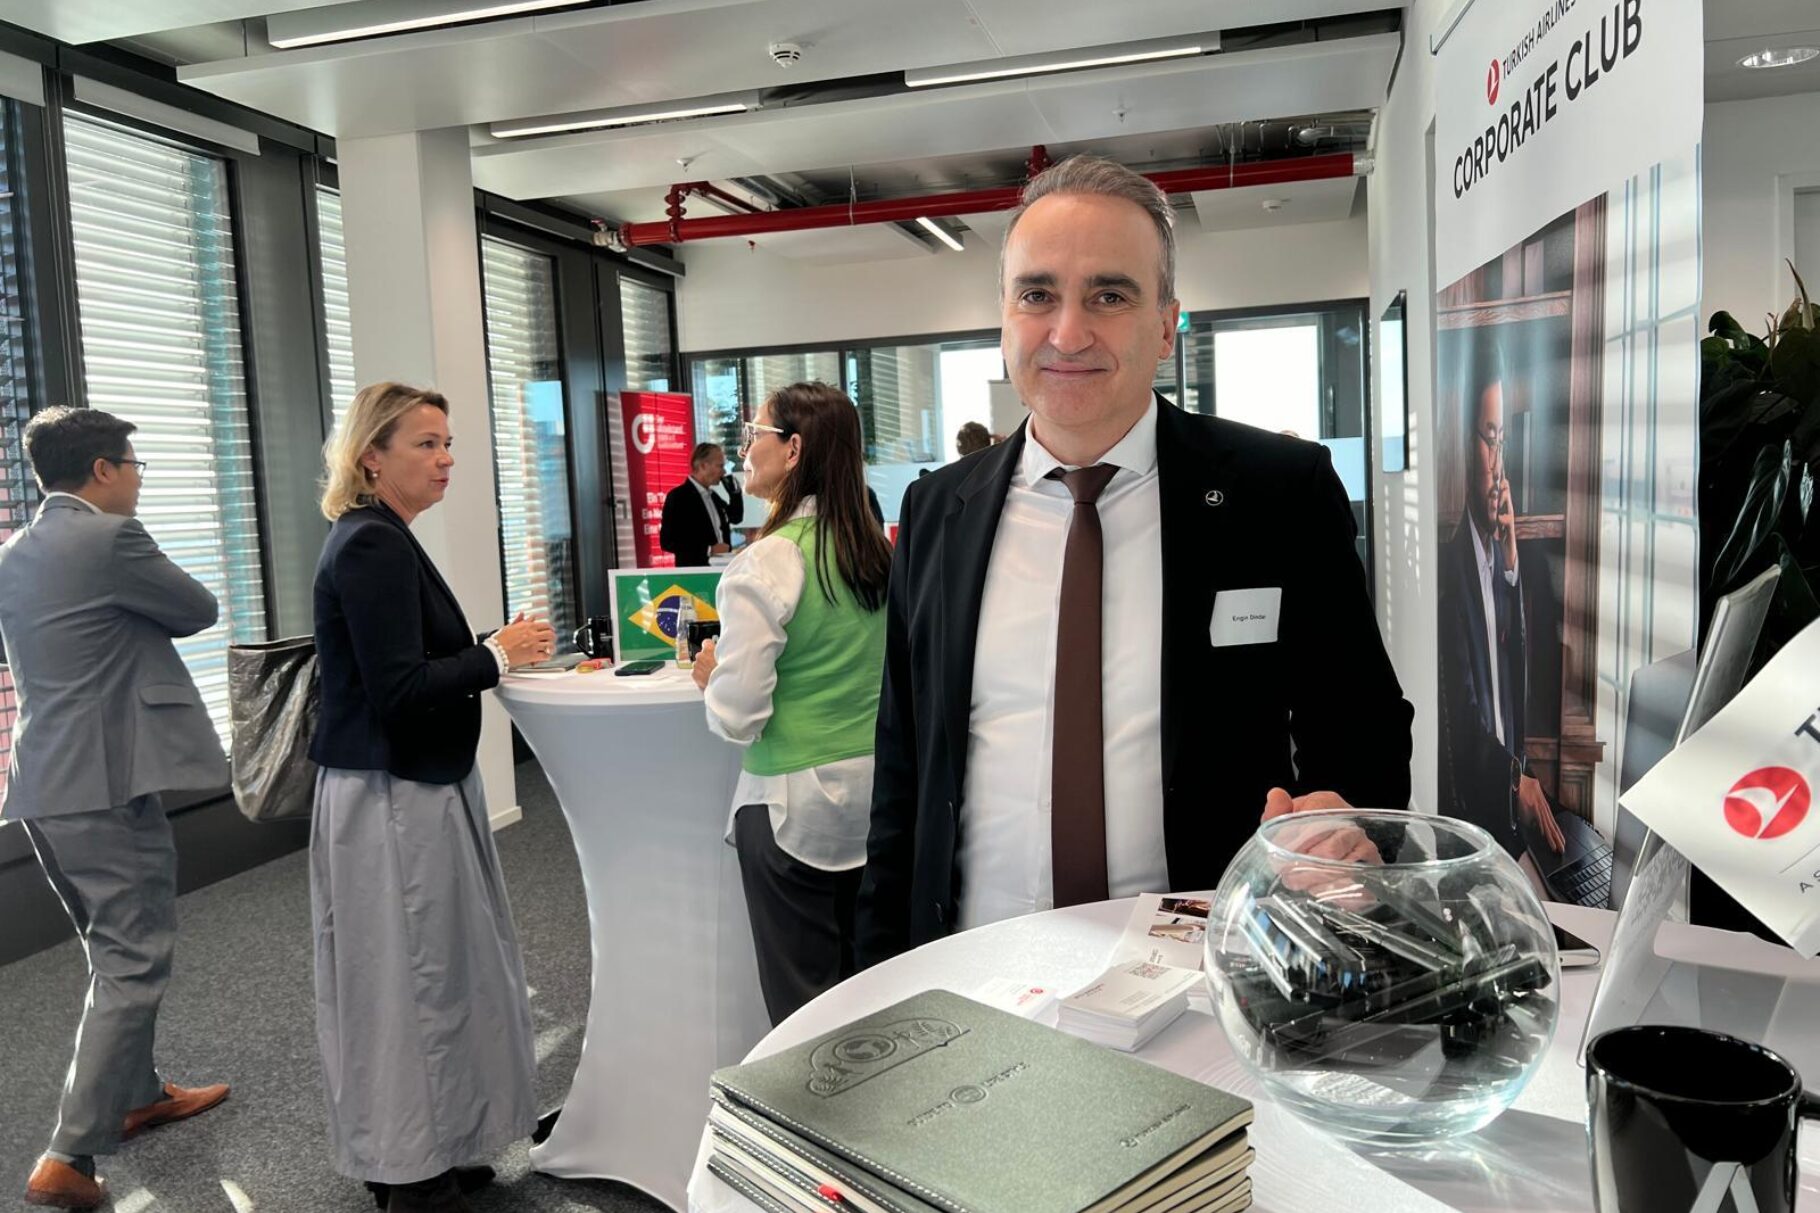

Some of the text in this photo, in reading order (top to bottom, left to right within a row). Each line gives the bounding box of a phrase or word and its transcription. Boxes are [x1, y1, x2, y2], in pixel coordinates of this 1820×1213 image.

[1453, 0, 1642, 199] CORPORATE CLUB
[1502, 27, 1534, 79] TURKISH
